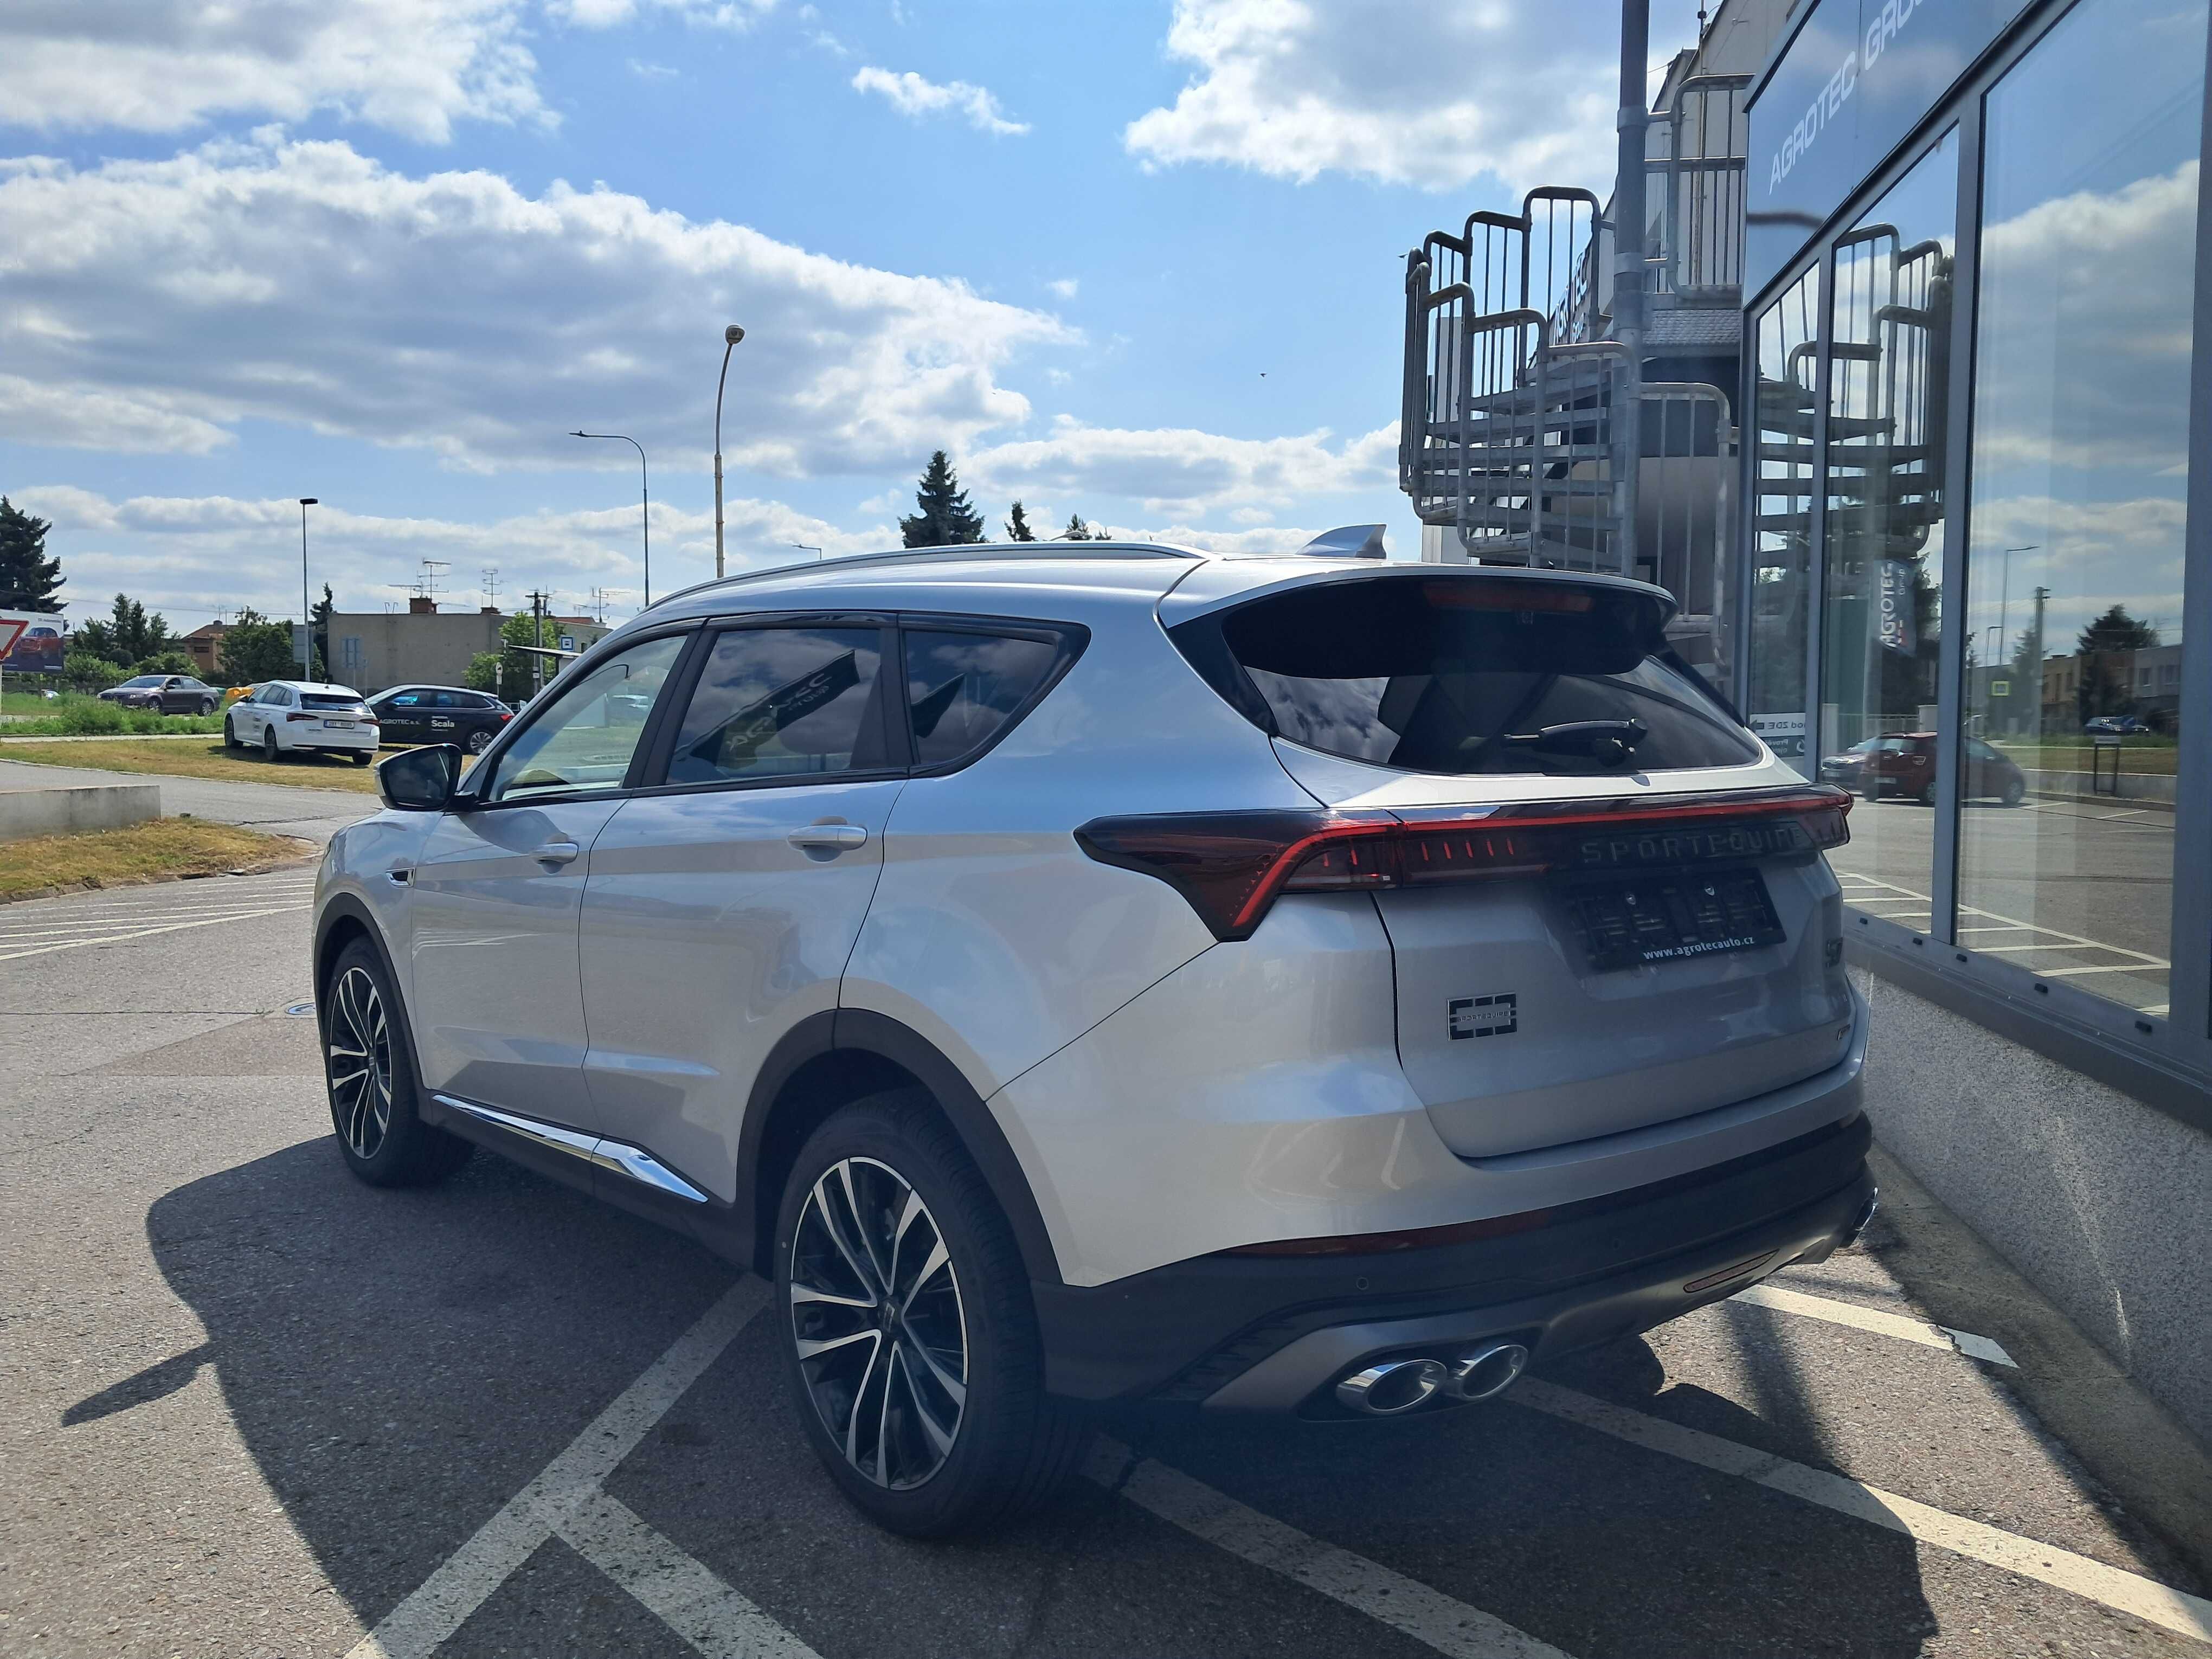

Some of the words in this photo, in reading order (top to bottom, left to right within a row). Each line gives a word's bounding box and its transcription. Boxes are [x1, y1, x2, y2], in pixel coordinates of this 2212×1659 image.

[1769, 51, 1856, 196] AGROTEC
[1865, 0, 1923, 71] GRO
[1879, 563, 1898, 648] AGROTEC
[431, 719, 455, 728] Scala
[1581, 827, 1801, 863] SPORTEQUIPE
[1643, 936, 1755, 960] www.agrotecauto.cz
